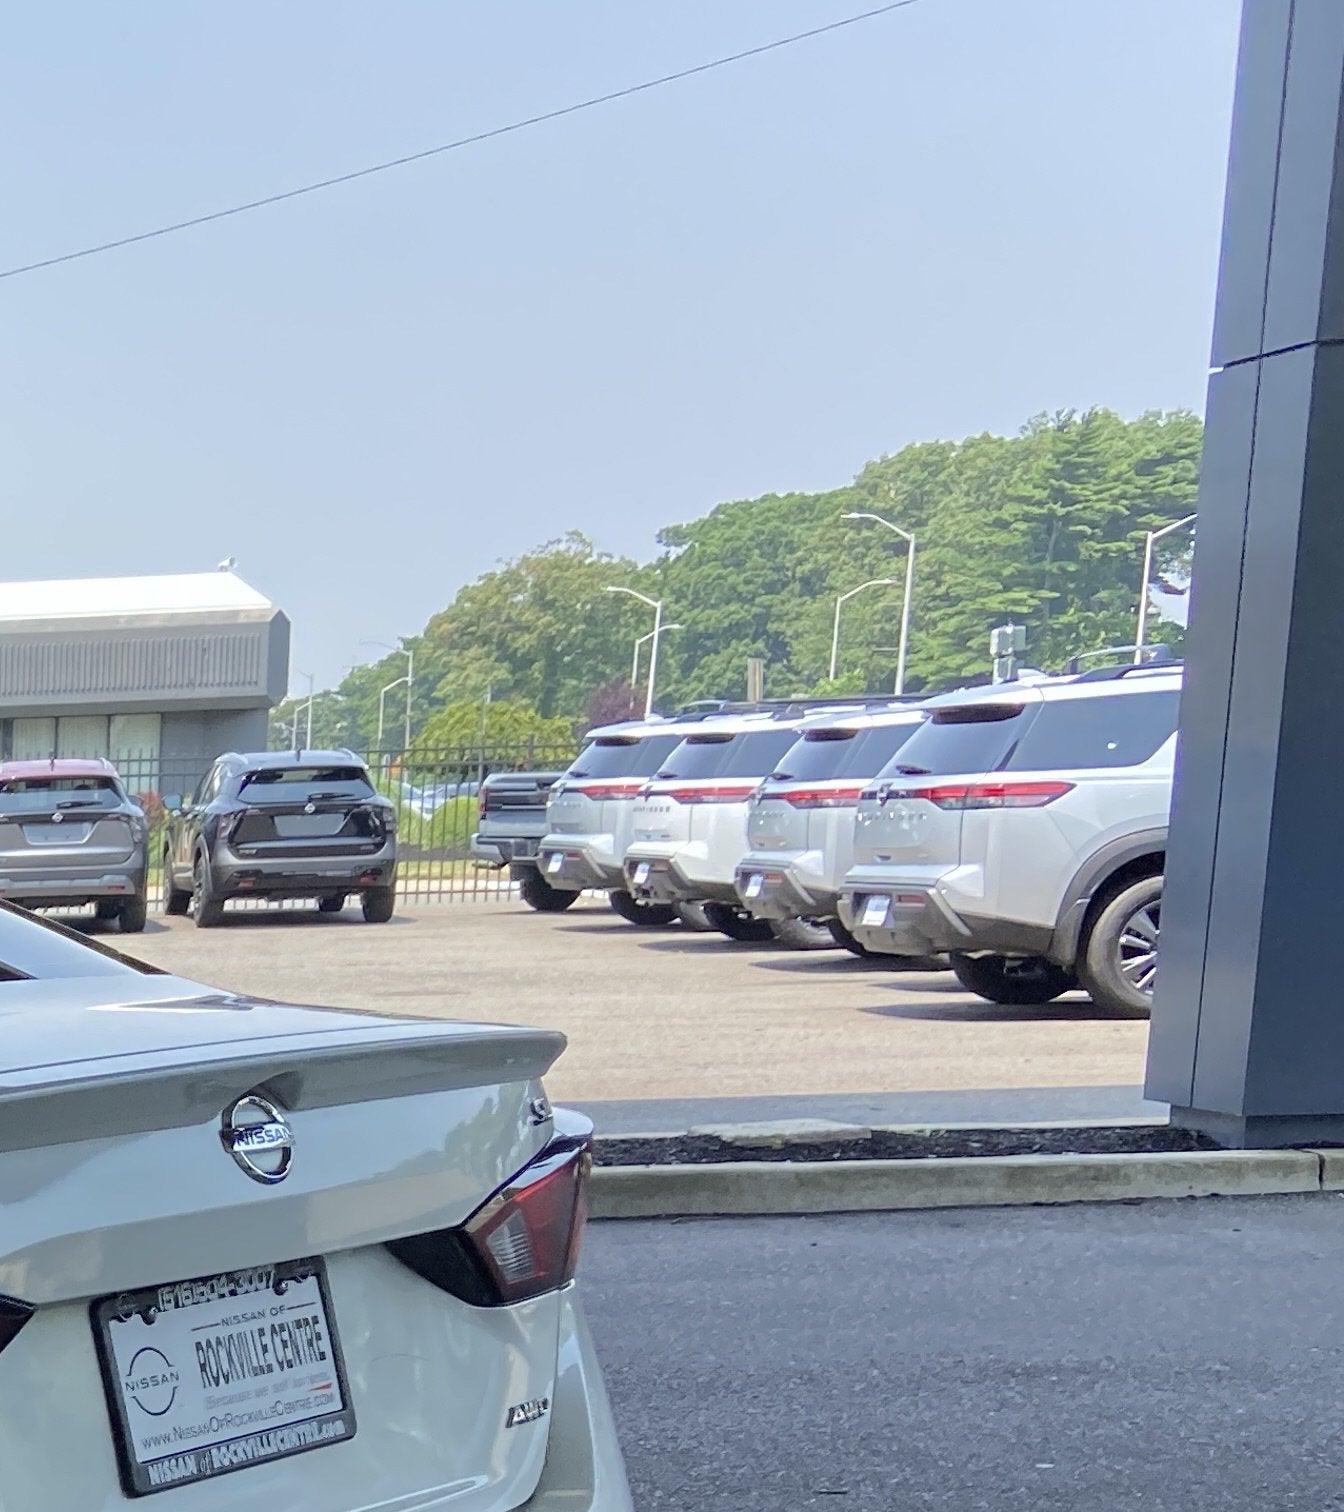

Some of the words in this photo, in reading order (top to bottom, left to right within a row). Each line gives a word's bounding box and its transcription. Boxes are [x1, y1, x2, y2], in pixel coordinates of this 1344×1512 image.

[233, 1128, 291, 1147] NISSAN
[221, 1311, 266, 1328] NISSAN
[269, 1304, 287, 1316] OF
[195, 1326, 274, 1390] ROCKVILLE
[270, 1315, 327, 1371] CENTRE
[125, 1370, 180, 1392] NISSAN
[505, 1397, 548, 1428] AWD
[148, 1454, 197, 1486] NISSAN
